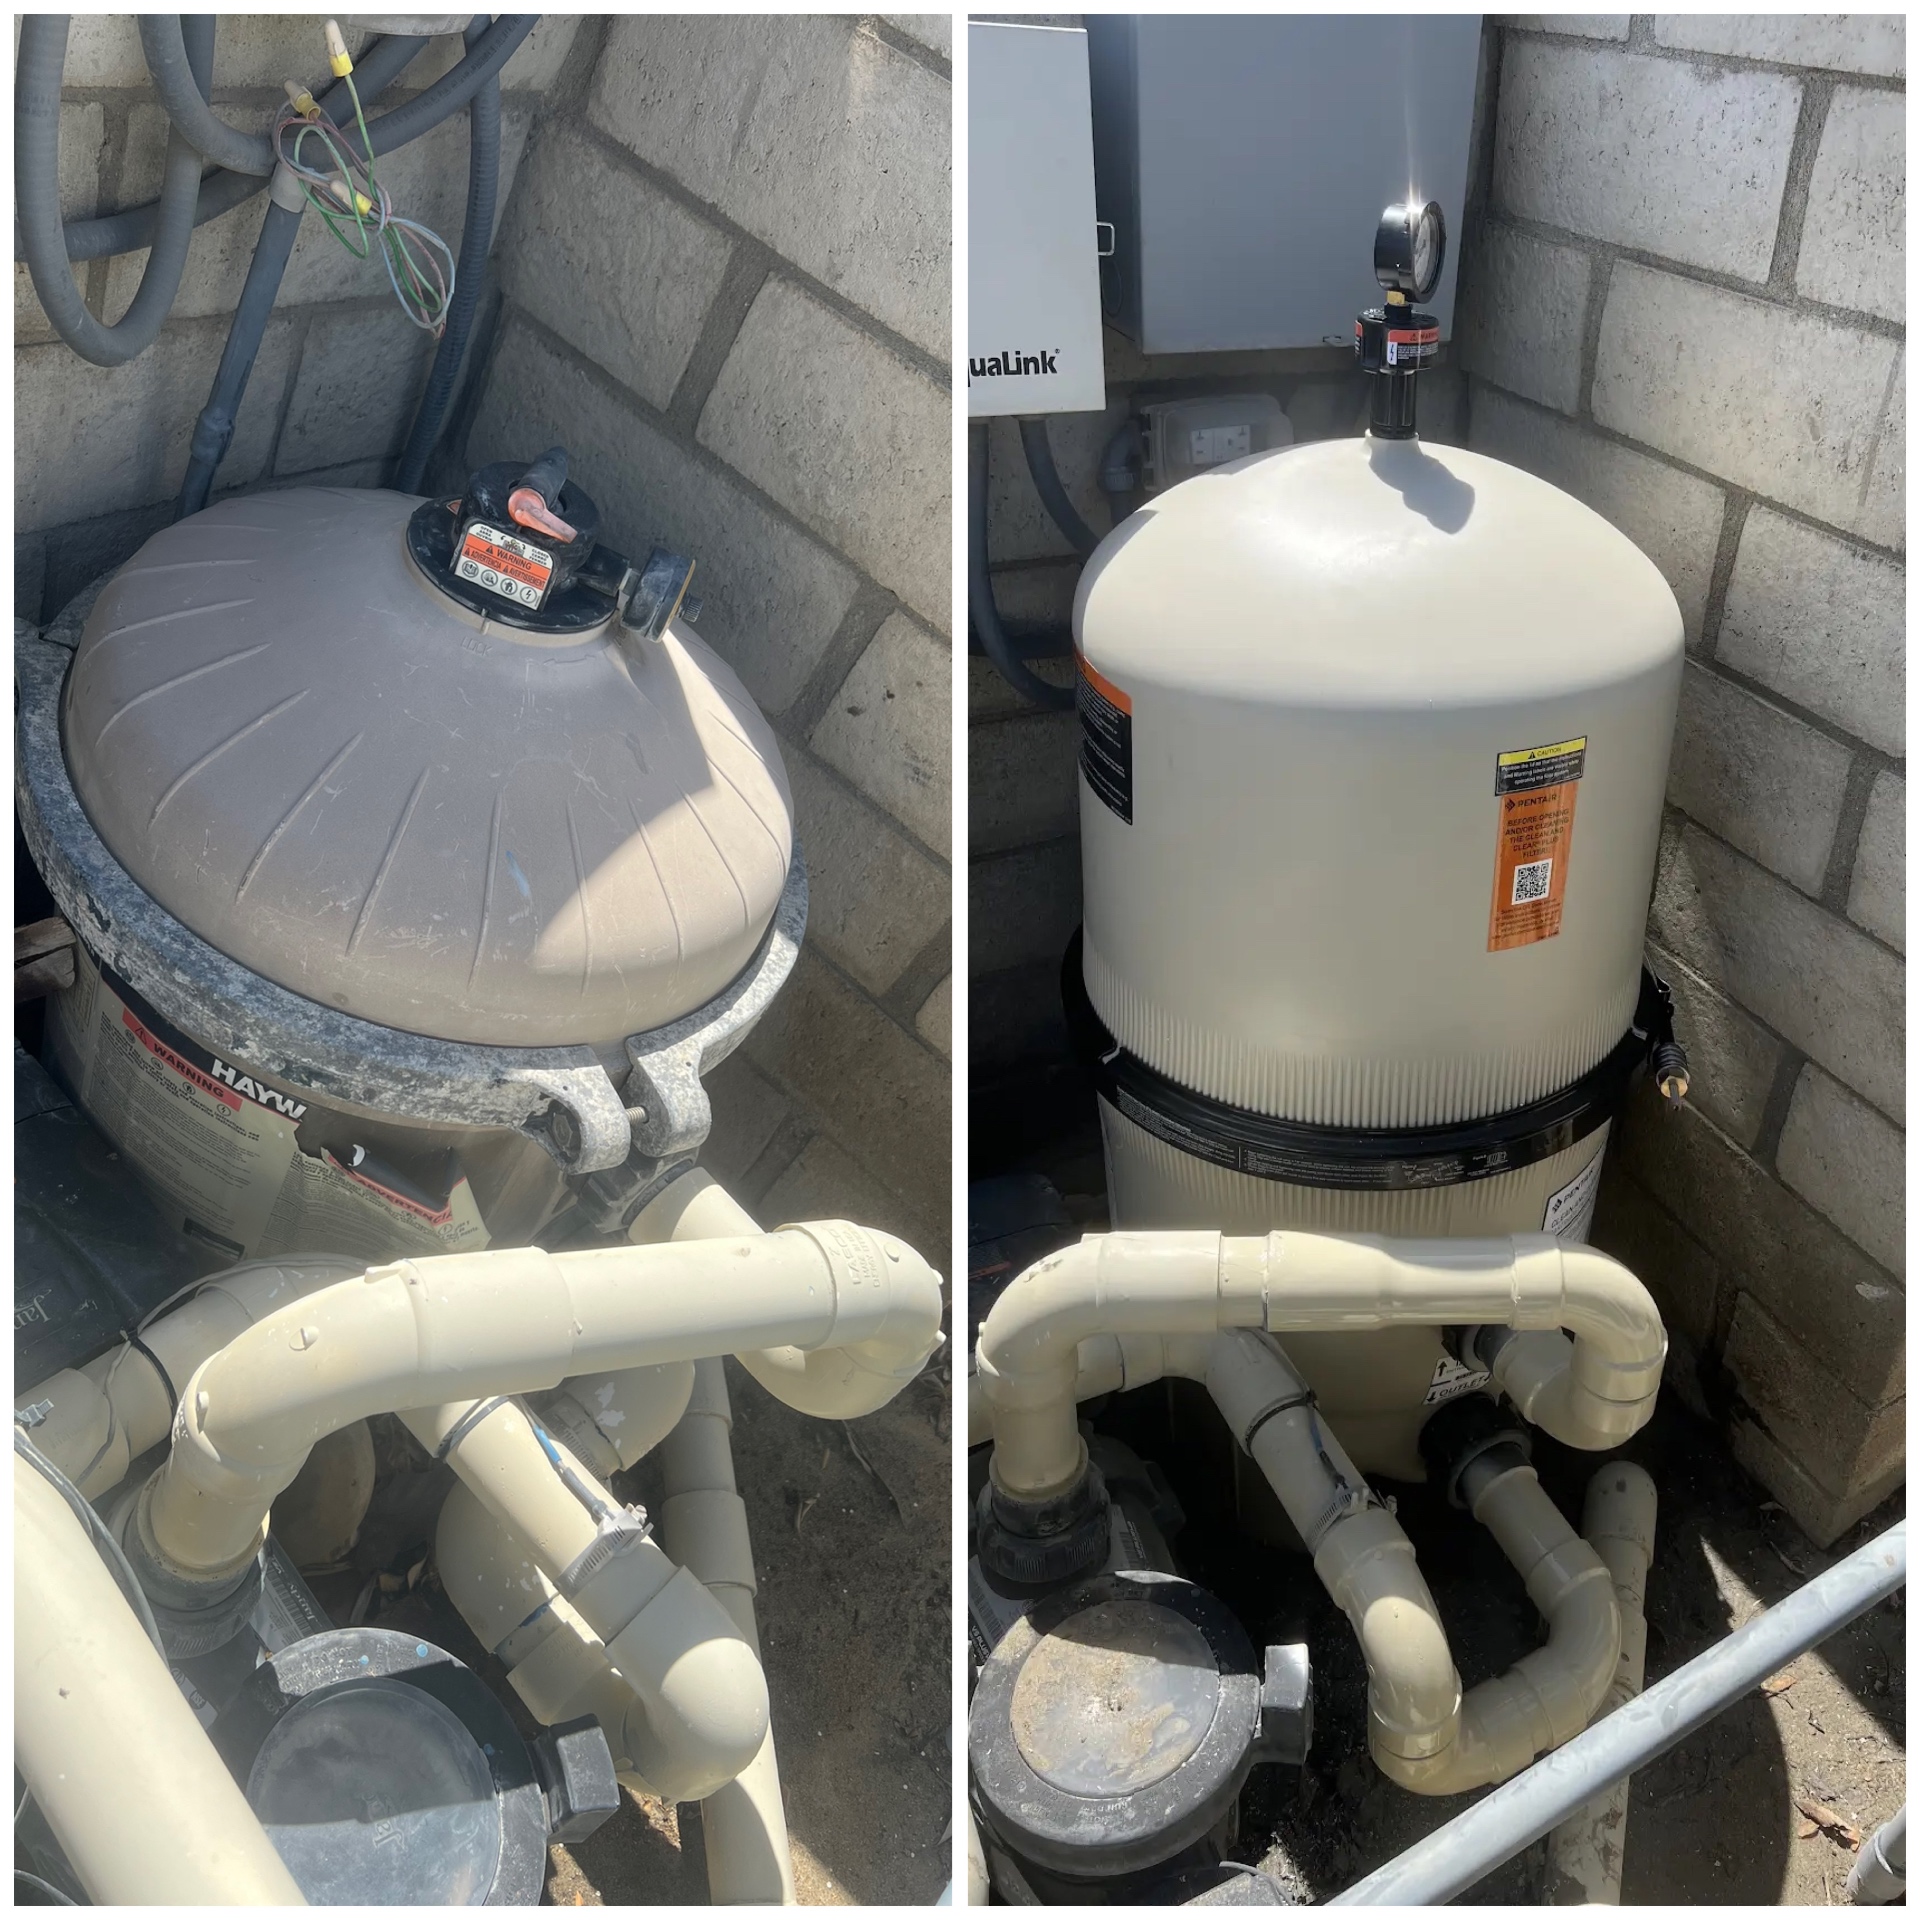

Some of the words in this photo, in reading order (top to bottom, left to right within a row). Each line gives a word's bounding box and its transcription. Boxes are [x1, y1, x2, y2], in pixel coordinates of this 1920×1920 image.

[968, 350, 1058, 387] uaLink
[471, 550, 502, 569] ADVERTENCIA
[509, 567, 546, 589] AVERTISSEMENT
[497, 549, 532, 571] WARNING
[1536, 746, 1562, 758] CAUTION
[1518, 794, 1557, 808] PENTAIR
[1505, 826, 1534, 836] AND/OR
[1535, 818, 1569, 830] CLEANING
[1507, 815, 1537, 827] BEFORE
[1539, 808, 1569, 820] OPENING
[1510, 835, 1523, 843] THE
[1525, 831, 1549, 841] CLEAN
[1550, 826, 1564, 835] AND
[153, 1043, 224, 1099] WARNING
[1440, 1375, 1486, 1397] OUTLET
